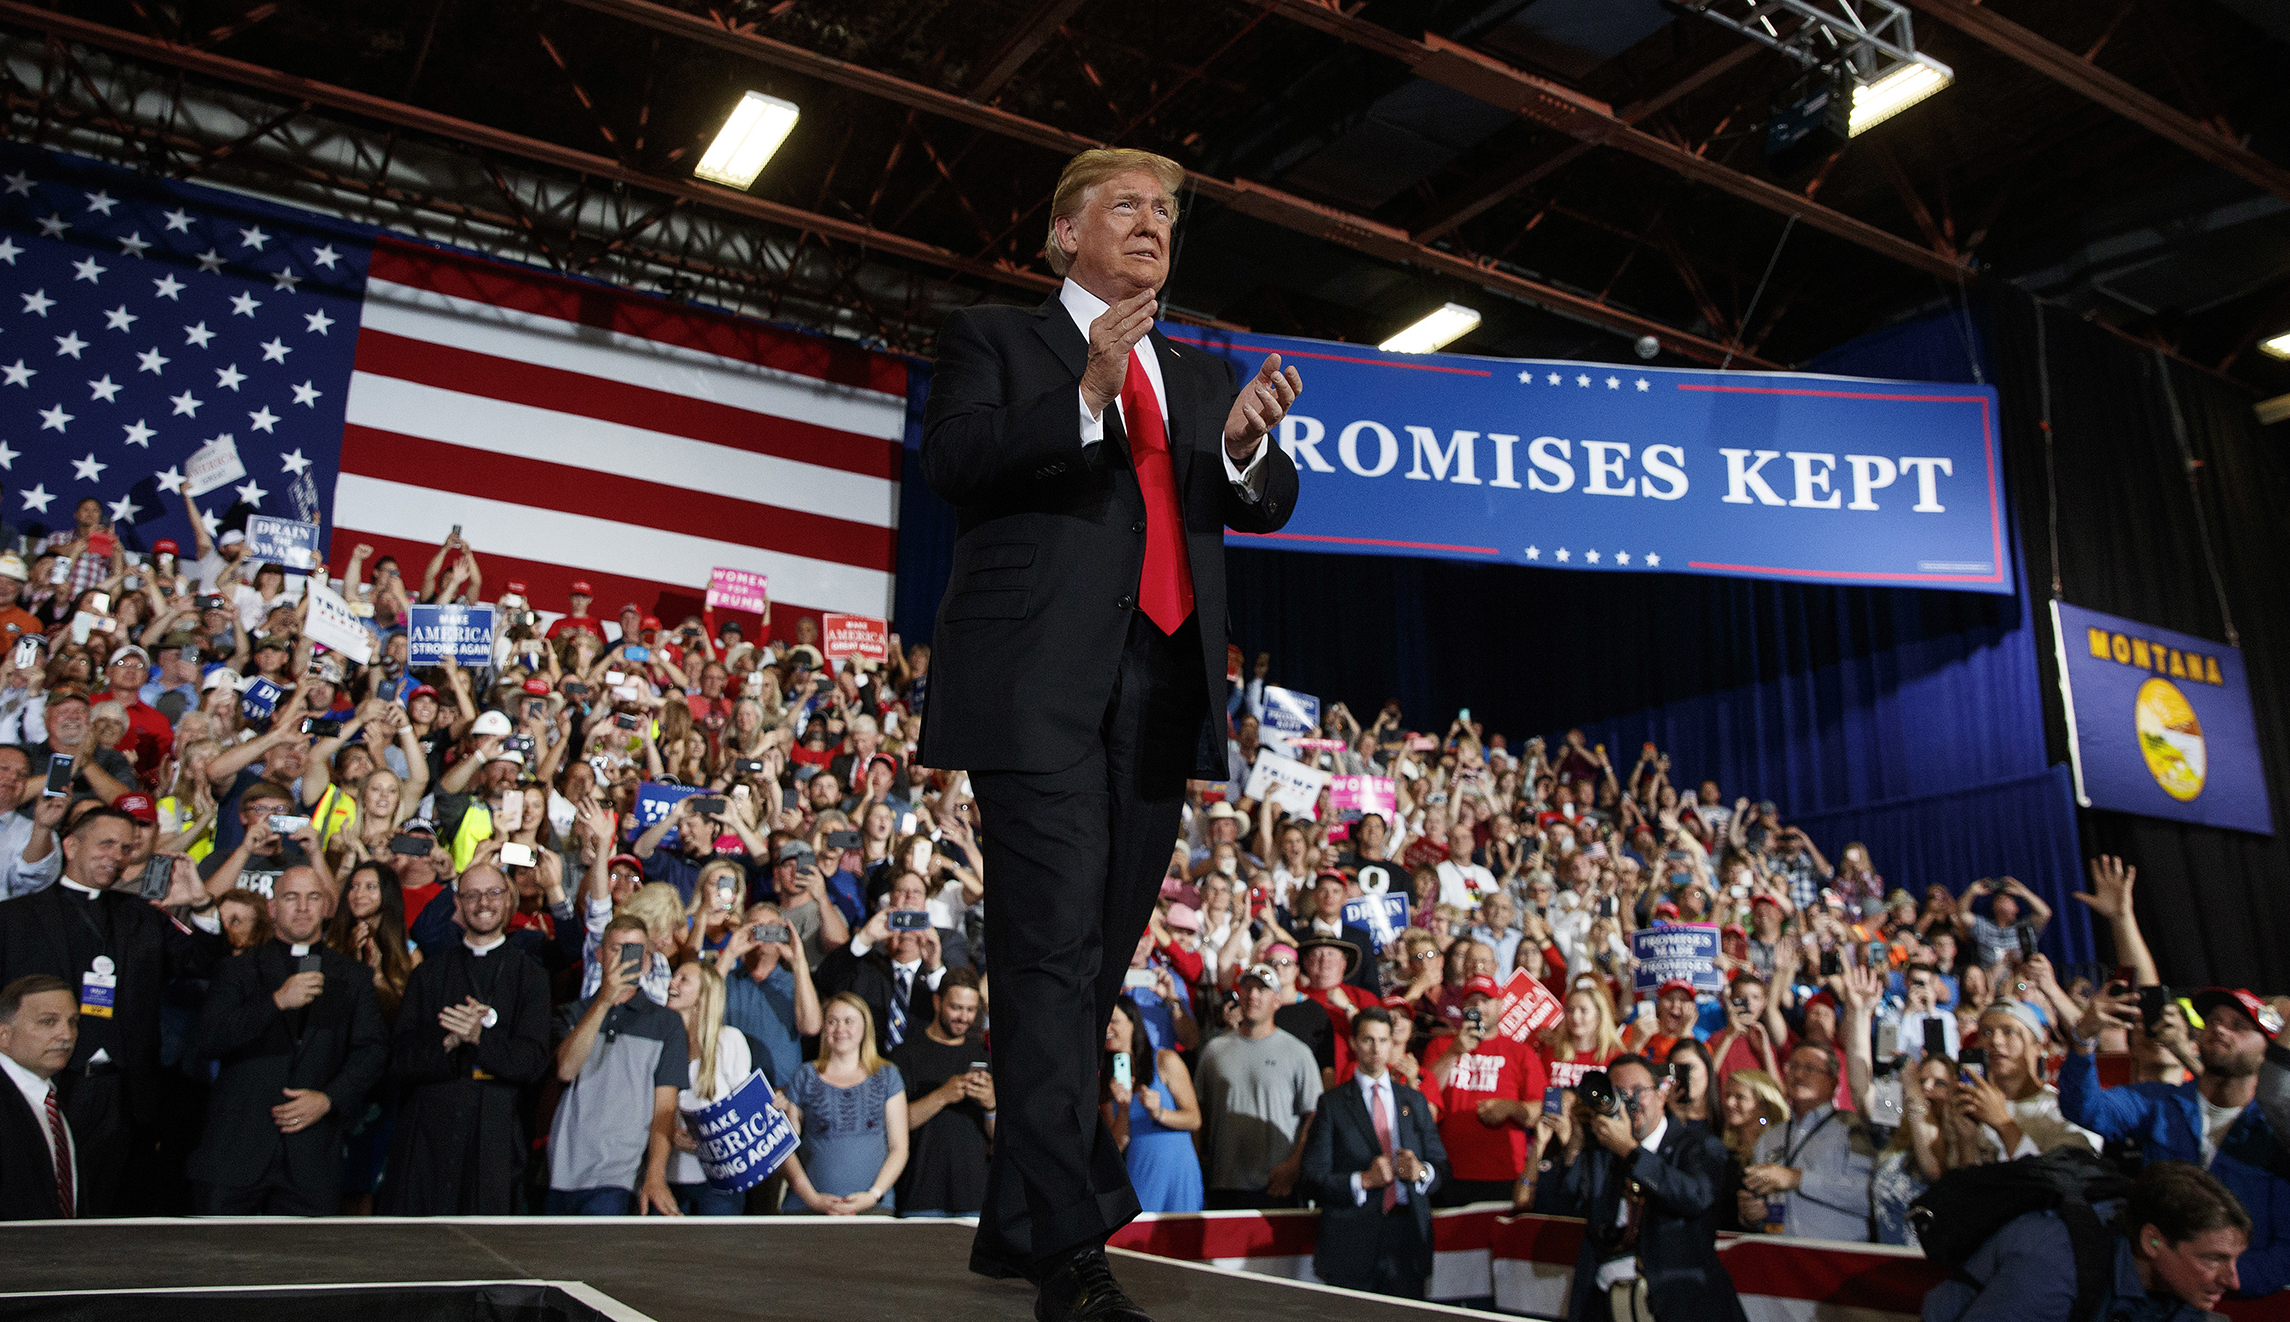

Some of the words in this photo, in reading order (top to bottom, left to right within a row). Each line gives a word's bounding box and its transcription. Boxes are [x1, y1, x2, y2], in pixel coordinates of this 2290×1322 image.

[1280, 415, 1690, 501] ROMISES
[1719, 448, 1953, 513] KEPT
[257, 521, 311, 540] DRAIN
[713, 570, 768, 588] WOMEN
[438, 614, 469, 625] MAKE
[412, 625, 492, 643] AMERICA
[412, 642, 458, 655] STRONG
[459, 643, 491, 656] AGAIN
[2087, 627, 2223, 687] MONTANA
[1262, 765, 1313, 790] TRUMP
[1331, 778, 1395, 793] WOEN
[1346, 899, 1402, 922] DRIN
[1640, 933, 1713, 949] PROMISES
[698, 1109, 740, 1137] MAKE
[718, 1119, 790, 1167] AGAIN
